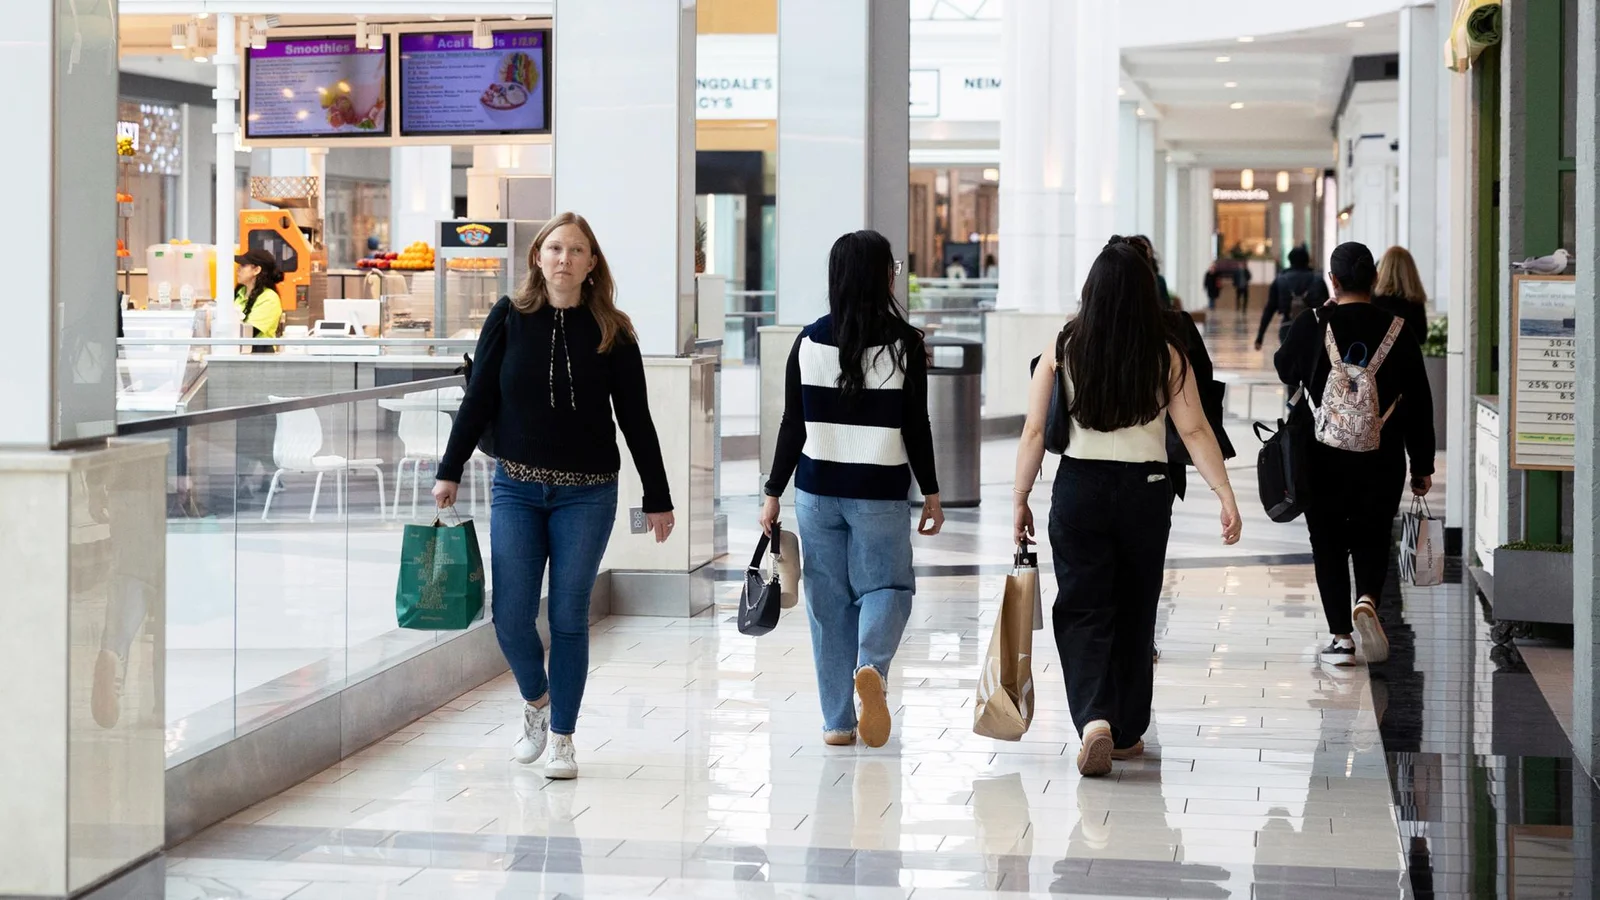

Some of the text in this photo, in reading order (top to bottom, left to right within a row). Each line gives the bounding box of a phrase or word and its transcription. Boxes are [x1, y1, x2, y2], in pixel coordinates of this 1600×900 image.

[285, 43, 350, 55] Smoothies
[1543, 350, 1560, 358] ALL
[1552, 360, 1558, 368] &
[1528, 380, 1574, 389] 25% OFF
[1547, 413, 1574, 421] 2 FOR
